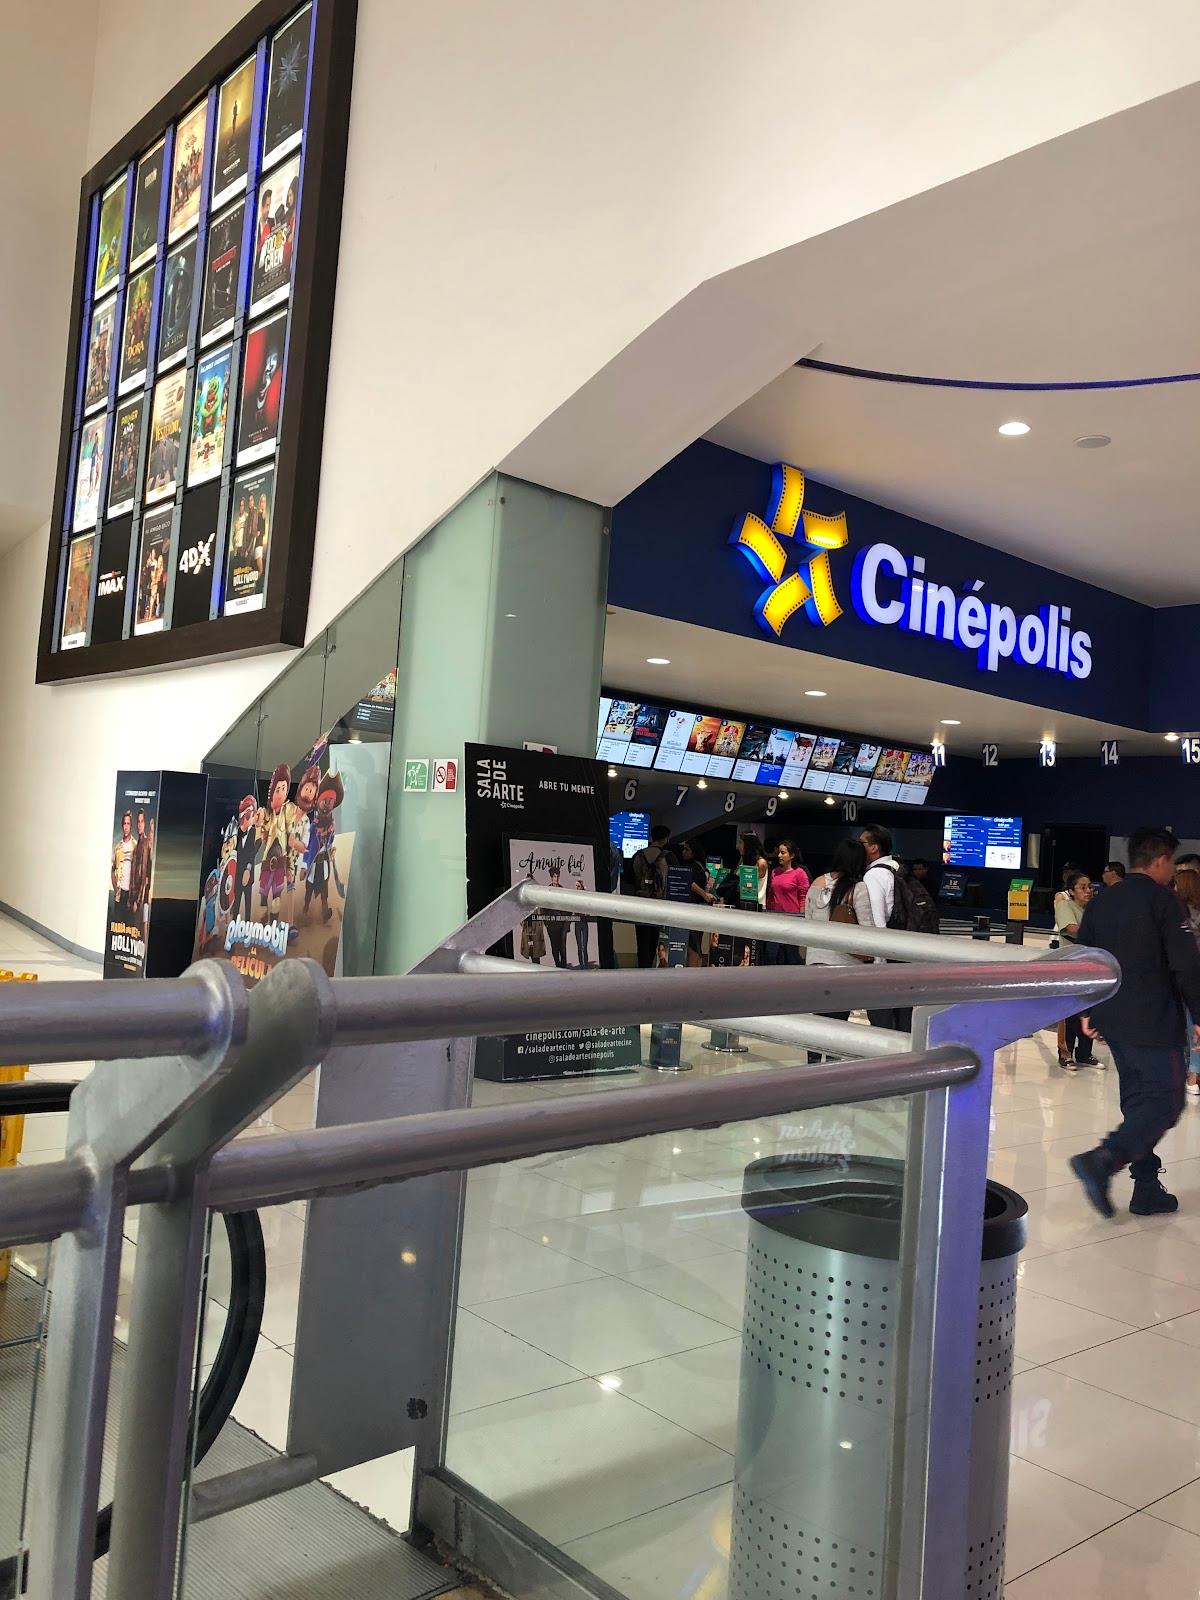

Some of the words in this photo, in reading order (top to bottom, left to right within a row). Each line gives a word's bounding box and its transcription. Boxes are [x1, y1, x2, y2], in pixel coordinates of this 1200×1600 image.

[264, 248, 284, 273] CAEN
[127, 340, 145, 359] DORA
[178, 532, 216, 575] 4DX
[98, 576, 125, 597] IMAX
[861, 542, 1092, 679] Cinépolis
[932, 743, 946, 766] 11
[982, 744, 998, 766] 12
[1040, 741, 1055, 767] 13
[1101, 741, 1119, 765] 14
[1181, 738, 1200, 763] 15
[476, 759, 491, 799] SALA
[493, 759, 506, 780] DE
[493, 782, 525, 801] ARTE
[538, 780, 558, 791] ABRE
[559, 782, 569, 791] TU
[571, 784, 595, 795] MENTE
[625, 780, 637, 800] 6
[676, 785, 688, 805] 7
[725, 792, 735, 812] 8
[766, 797, 777, 816] 9
[842, 801, 857, 821] 10
[518, 851, 566, 874] Amante
[223, 913, 290, 956] playmobil
[525, 1026, 626, 1042] cinepolis.com/sala-de-arte
[524, 1042, 576, 1055] /saladeartecine
